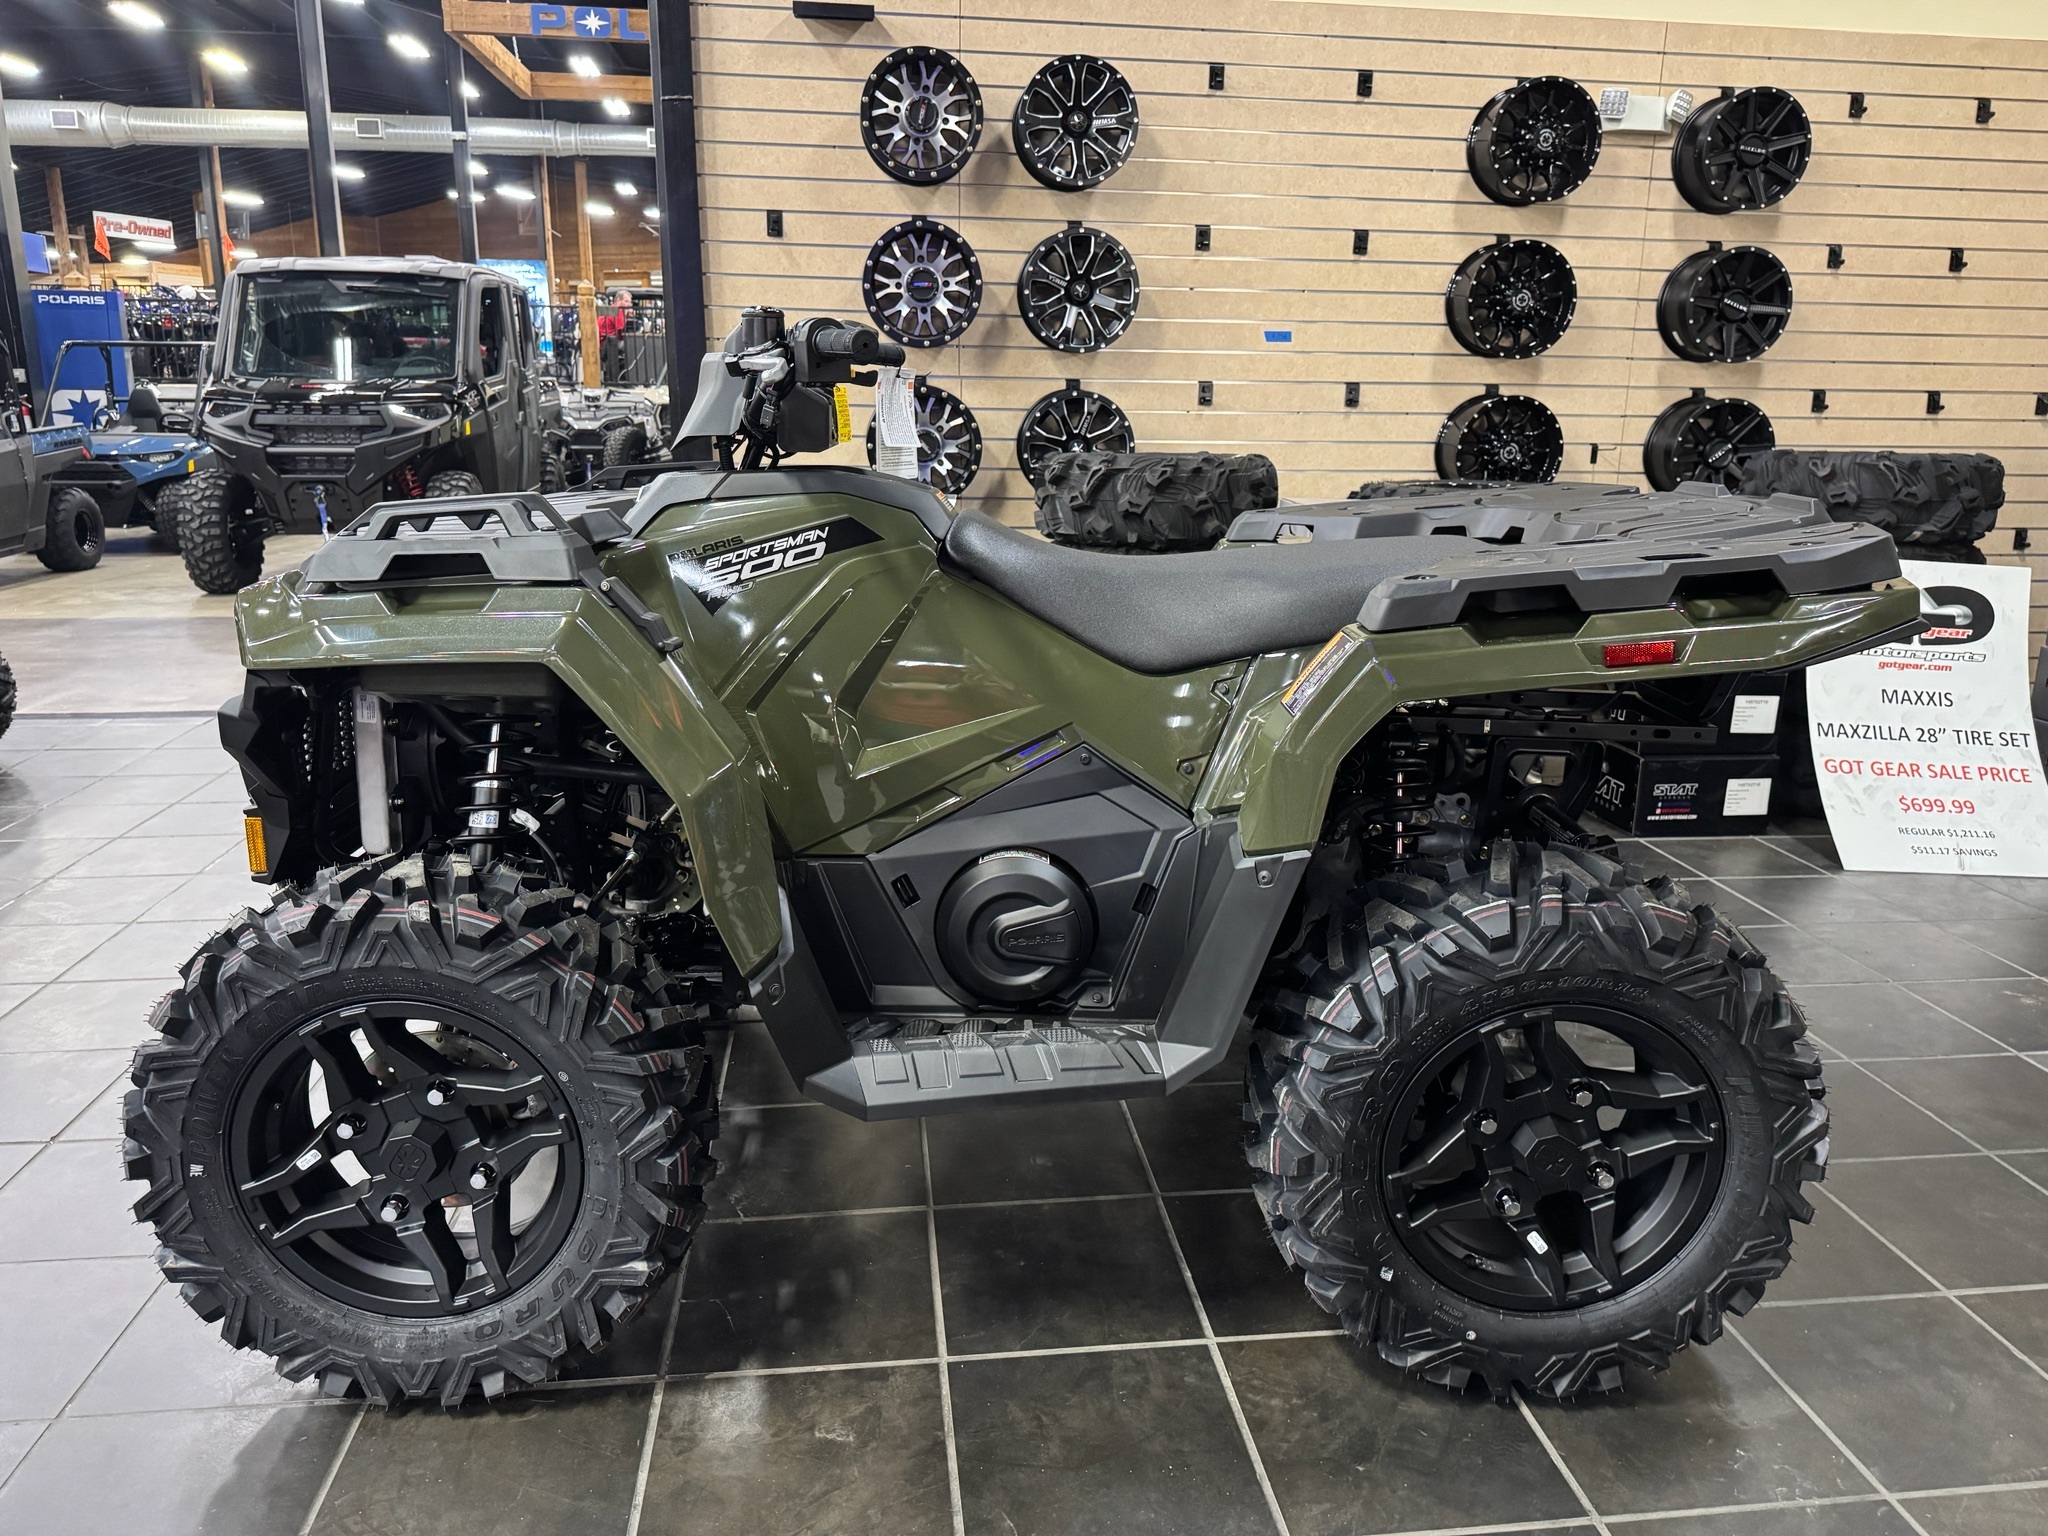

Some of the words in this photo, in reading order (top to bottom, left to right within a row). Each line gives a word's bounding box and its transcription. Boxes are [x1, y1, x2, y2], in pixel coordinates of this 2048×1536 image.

[96, 216, 172, 239] Pre-Owned
[38, 295, 106, 305] POLARIS
[705, 526, 830, 570] SPORTSMAN
[699, 541, 827, 593] 500
[1923, 628, 1972, 638] gear
[1857, 647, 1986, 662] otorsports
[1878, 661, 1952, 672] gotgear.com
[1881, 689, 1954, 707] MAXXIS
[1817, 722, 1911, 742] MAXZILLA
[1952, 729, 1994, 746] TIRE
[1999, 732, 2031, 748] SET
[1824, 758, 1864, 775] GOT
[1870, 761, 1923, 778] GEAR
[1927, 763, 1973, 781] SALE
[1978, 766, 2033, 783] PRICE
[1653, 783, 1699, 796] STAT
[1898, 795, 1976, 814] $699.99
[1898, 827, 1946, 837] REGULAR
[1947, 828, 1996, 839] $1,211.16
[1911, 845, 1950, 855] $511.17
[1953, 847, 1998, 857] SAVINGS
[1009, 934, 1065, 946] POLARIS
[475, 1229, 598, 1342] DURO
